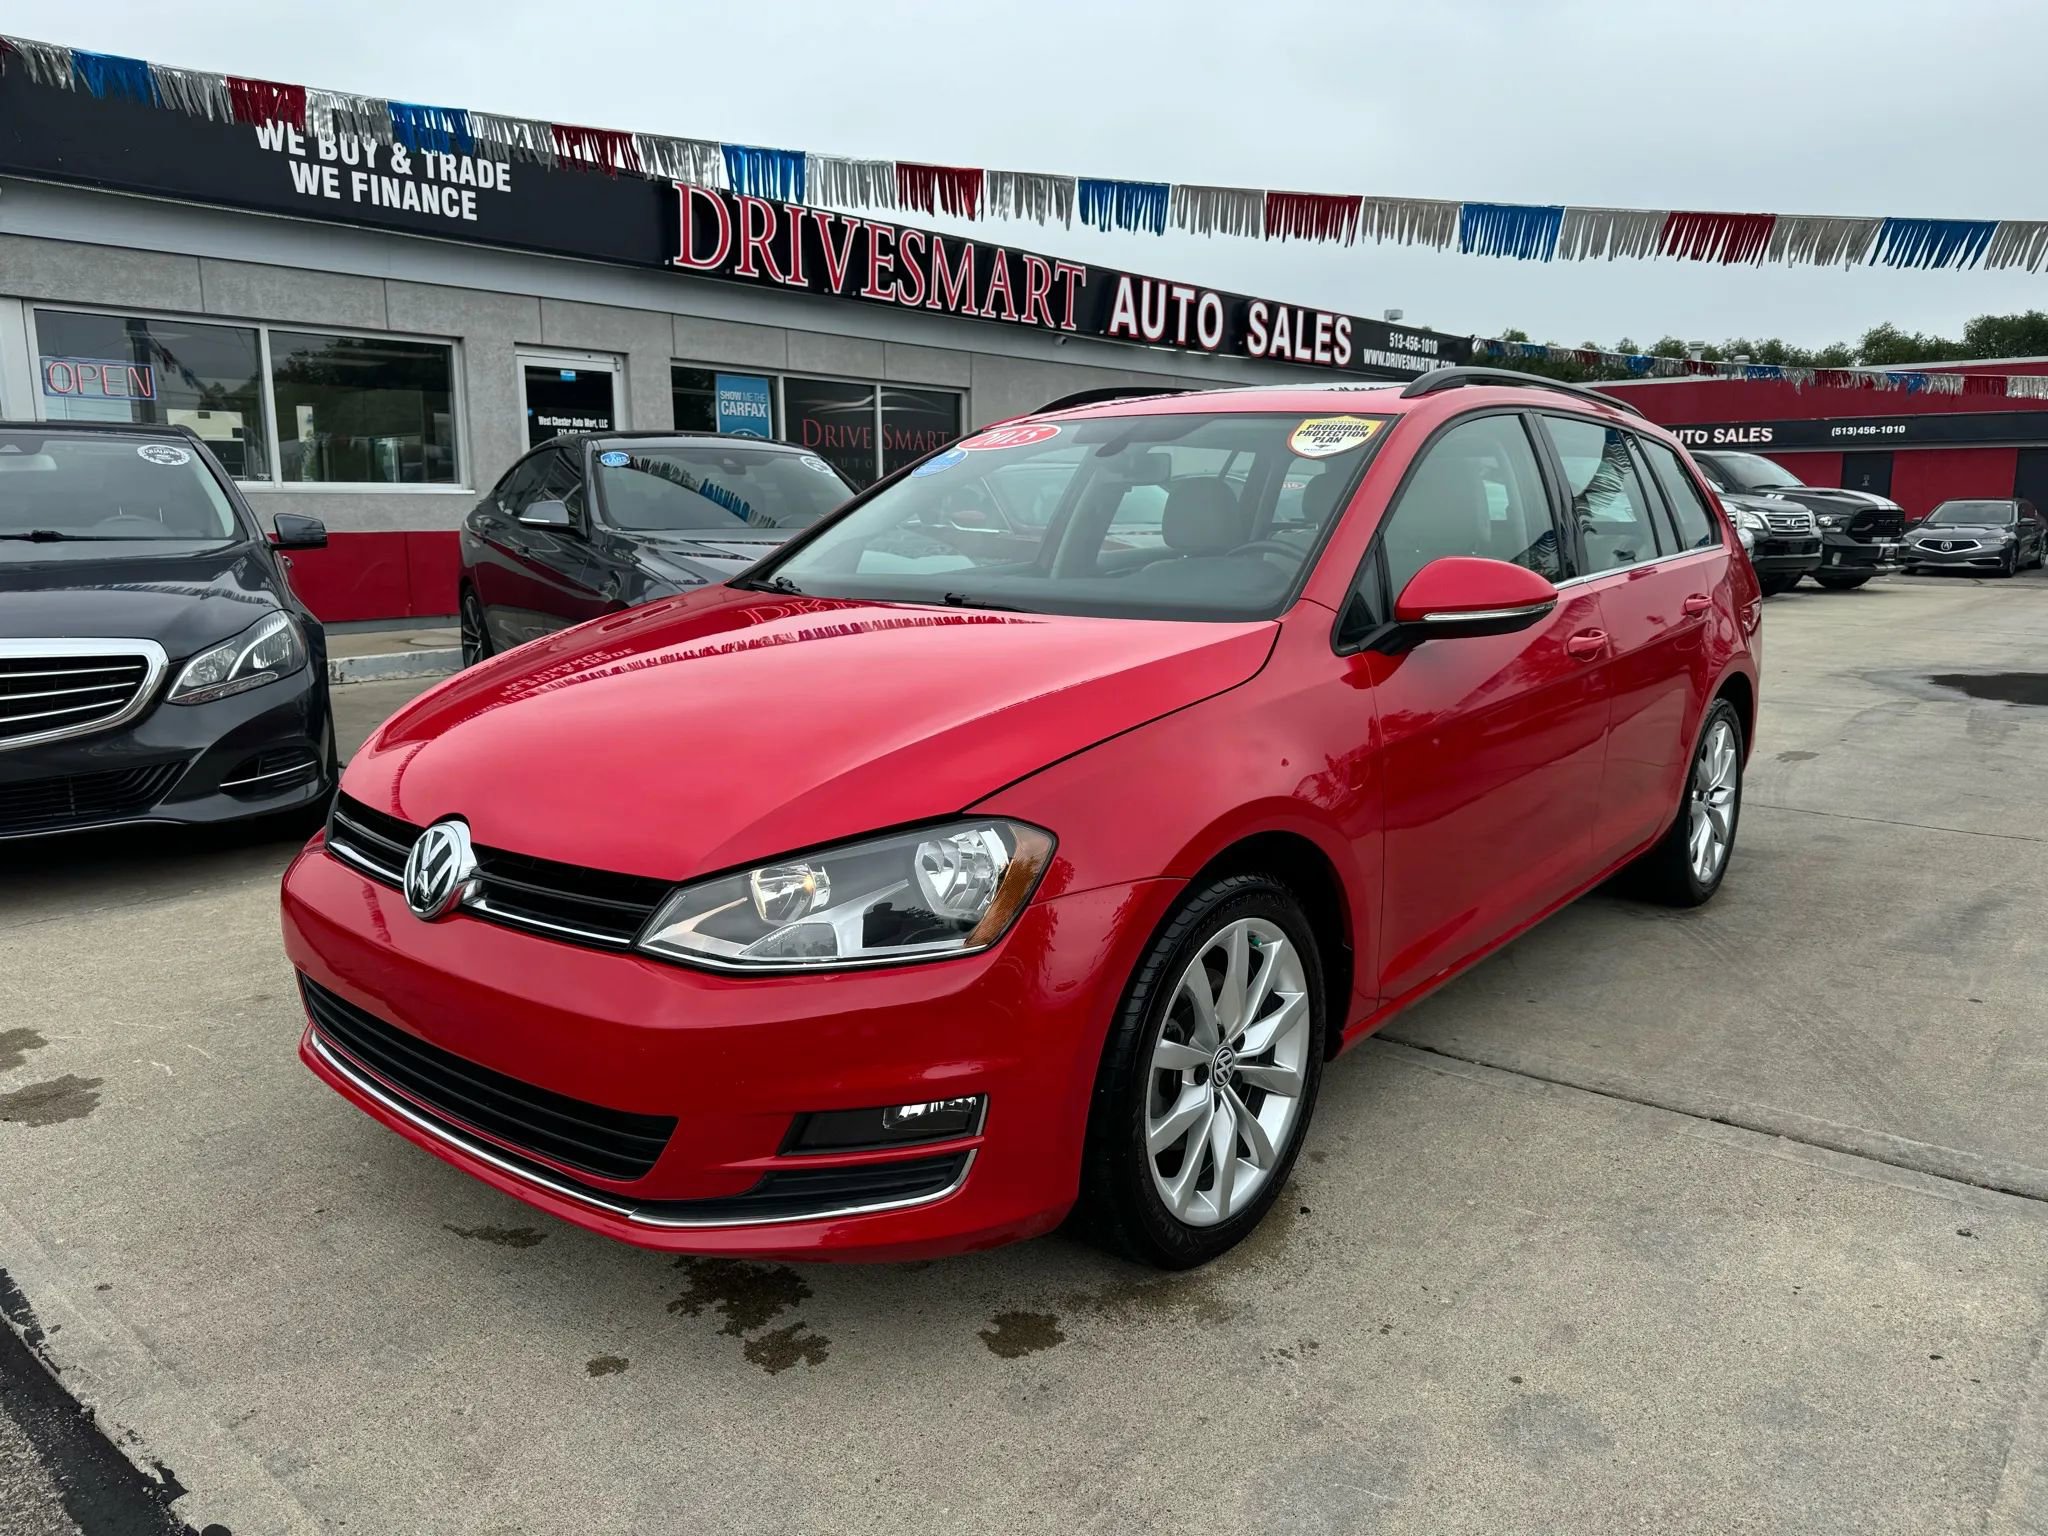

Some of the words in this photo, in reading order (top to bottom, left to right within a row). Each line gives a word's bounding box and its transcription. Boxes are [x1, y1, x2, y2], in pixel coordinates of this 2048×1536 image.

[255, 118, 306, 157] WE
[317, 131, 378, 168] BUY
[390, 142, 413, 175] &
[421, 147, 512, 192] TRADE
[288, 160, 341, 199] WE
[351, 171, 478, 221] FINANCE
[672, 180, 1087, 331] DRIVESMART
[1108, 273, 1224, 350] AUTO
[1247, 298, 1352, 367] SALES
[1389, 332, 1438, 354] 513-456-1010
[1363, 348, 1457, 372] WWW.DRIVESMARTWCCO
[48, 361, 151, 397] OPEN
[720, 390, 742, 400] SHOW
[721, 401, 767, 417] CARFAX
[538, 416, 551, 425] West
[552, 416, 571, 426] Chester
[572, 417, 583, 427] Auto
[599, 419, 608, 428] LLC
[1831, 425, 1906, 437] (513)456-1010
[802, 419, 872, 449] DRIVE
[1296, 430, 1369, 438] PROTECTION
[1672, 429, 1708, 444] UTO
[1713, 427, 1773, 443] SALES
